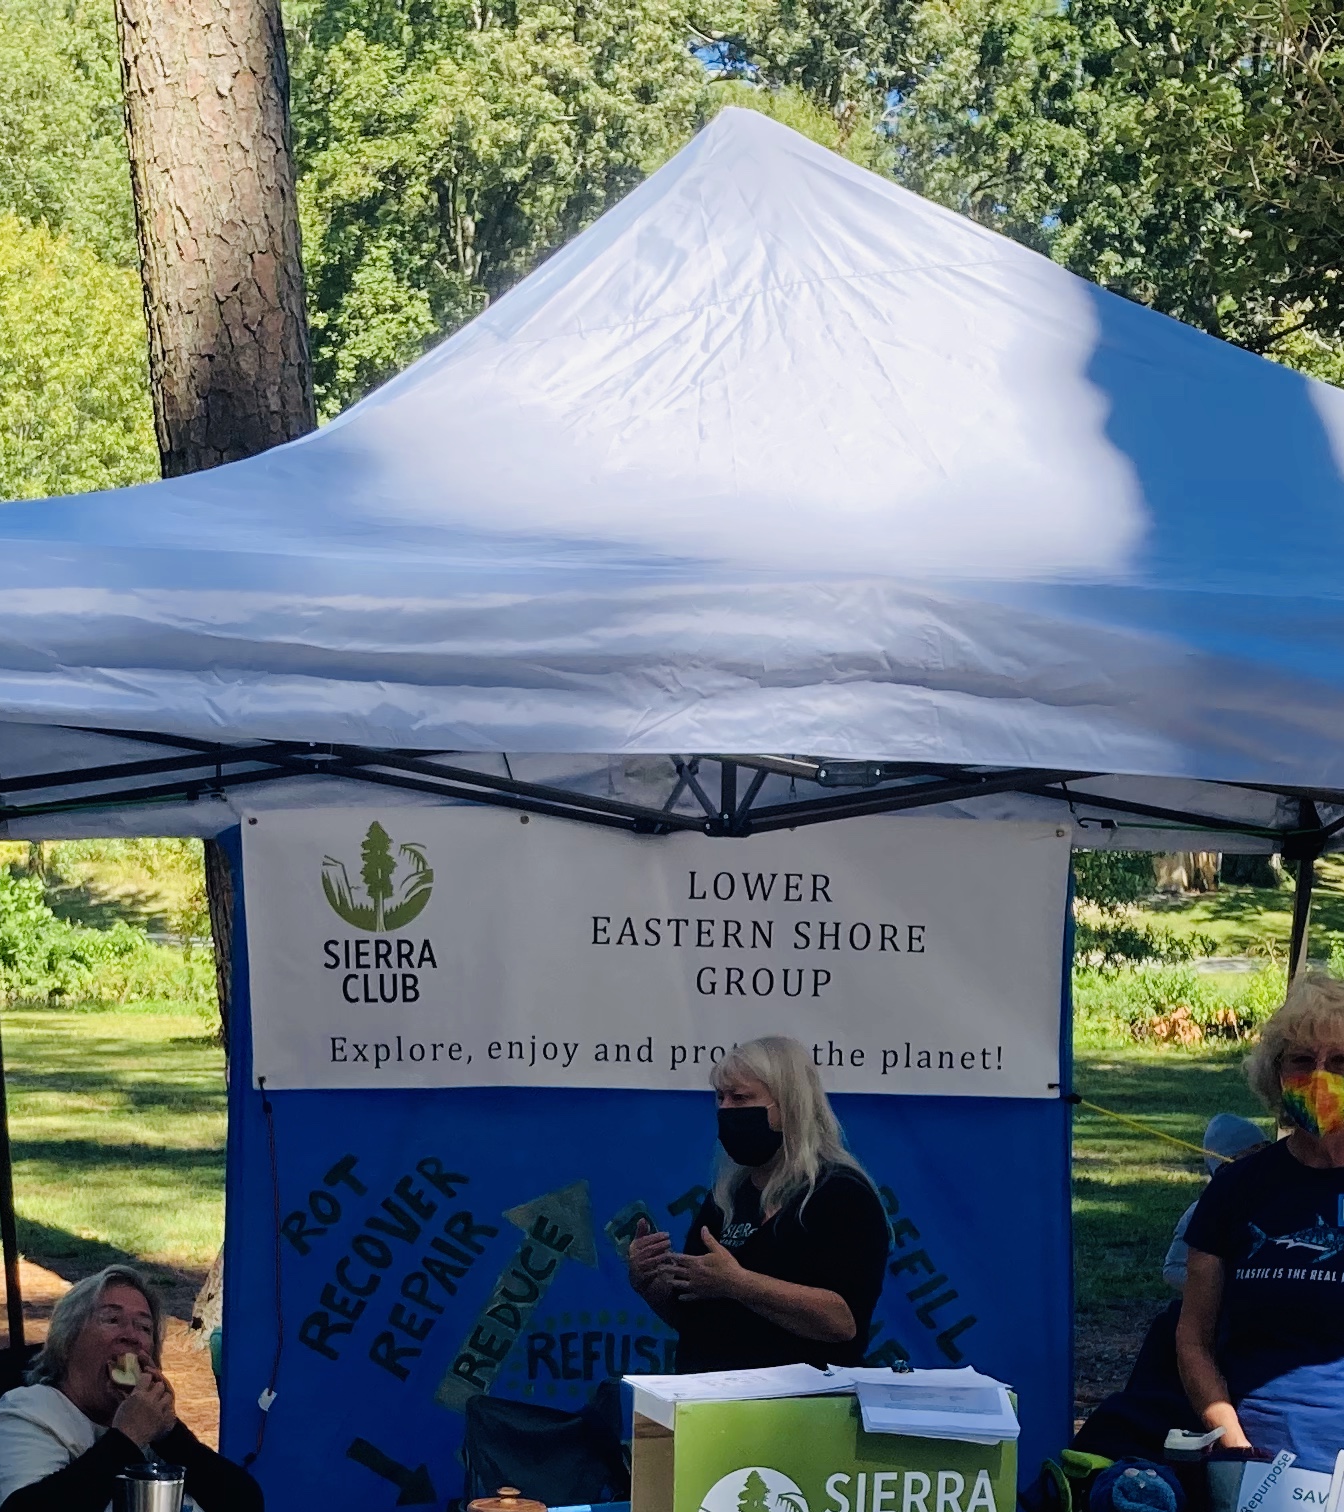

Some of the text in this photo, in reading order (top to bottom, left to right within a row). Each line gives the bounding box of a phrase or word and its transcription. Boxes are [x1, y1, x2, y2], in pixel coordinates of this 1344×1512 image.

[688, 871, 833, 903] LOWER
[323, 938, 438, 970] SIERRA
[591, 915, 927, 954] EASTERN SHORE
[342, 973, 420, 1004] CLUB
[696, 966, 832, 998] GROUP
[329, 1035, 473, 1069] Explore,
[487, 1034, 580, 1068] enjoy
[594, 1037, 654, 1064] and
[811, 1040, 865, 1067] the
[881, 1042, 1003, 1075] planet!
[281, 1153, 369, 1257] ROT
[298, 1156, 471, 1361] RECOVER
[1272, 1267, 1284, 1279] IS
[1287, 1268, 1307, 1280] THE
[1309, 1269, 1337, 1282] REAL
[368, 1210, 500, 1382] REPAIR
[452, 1215, 575, 1390] REDUCE
